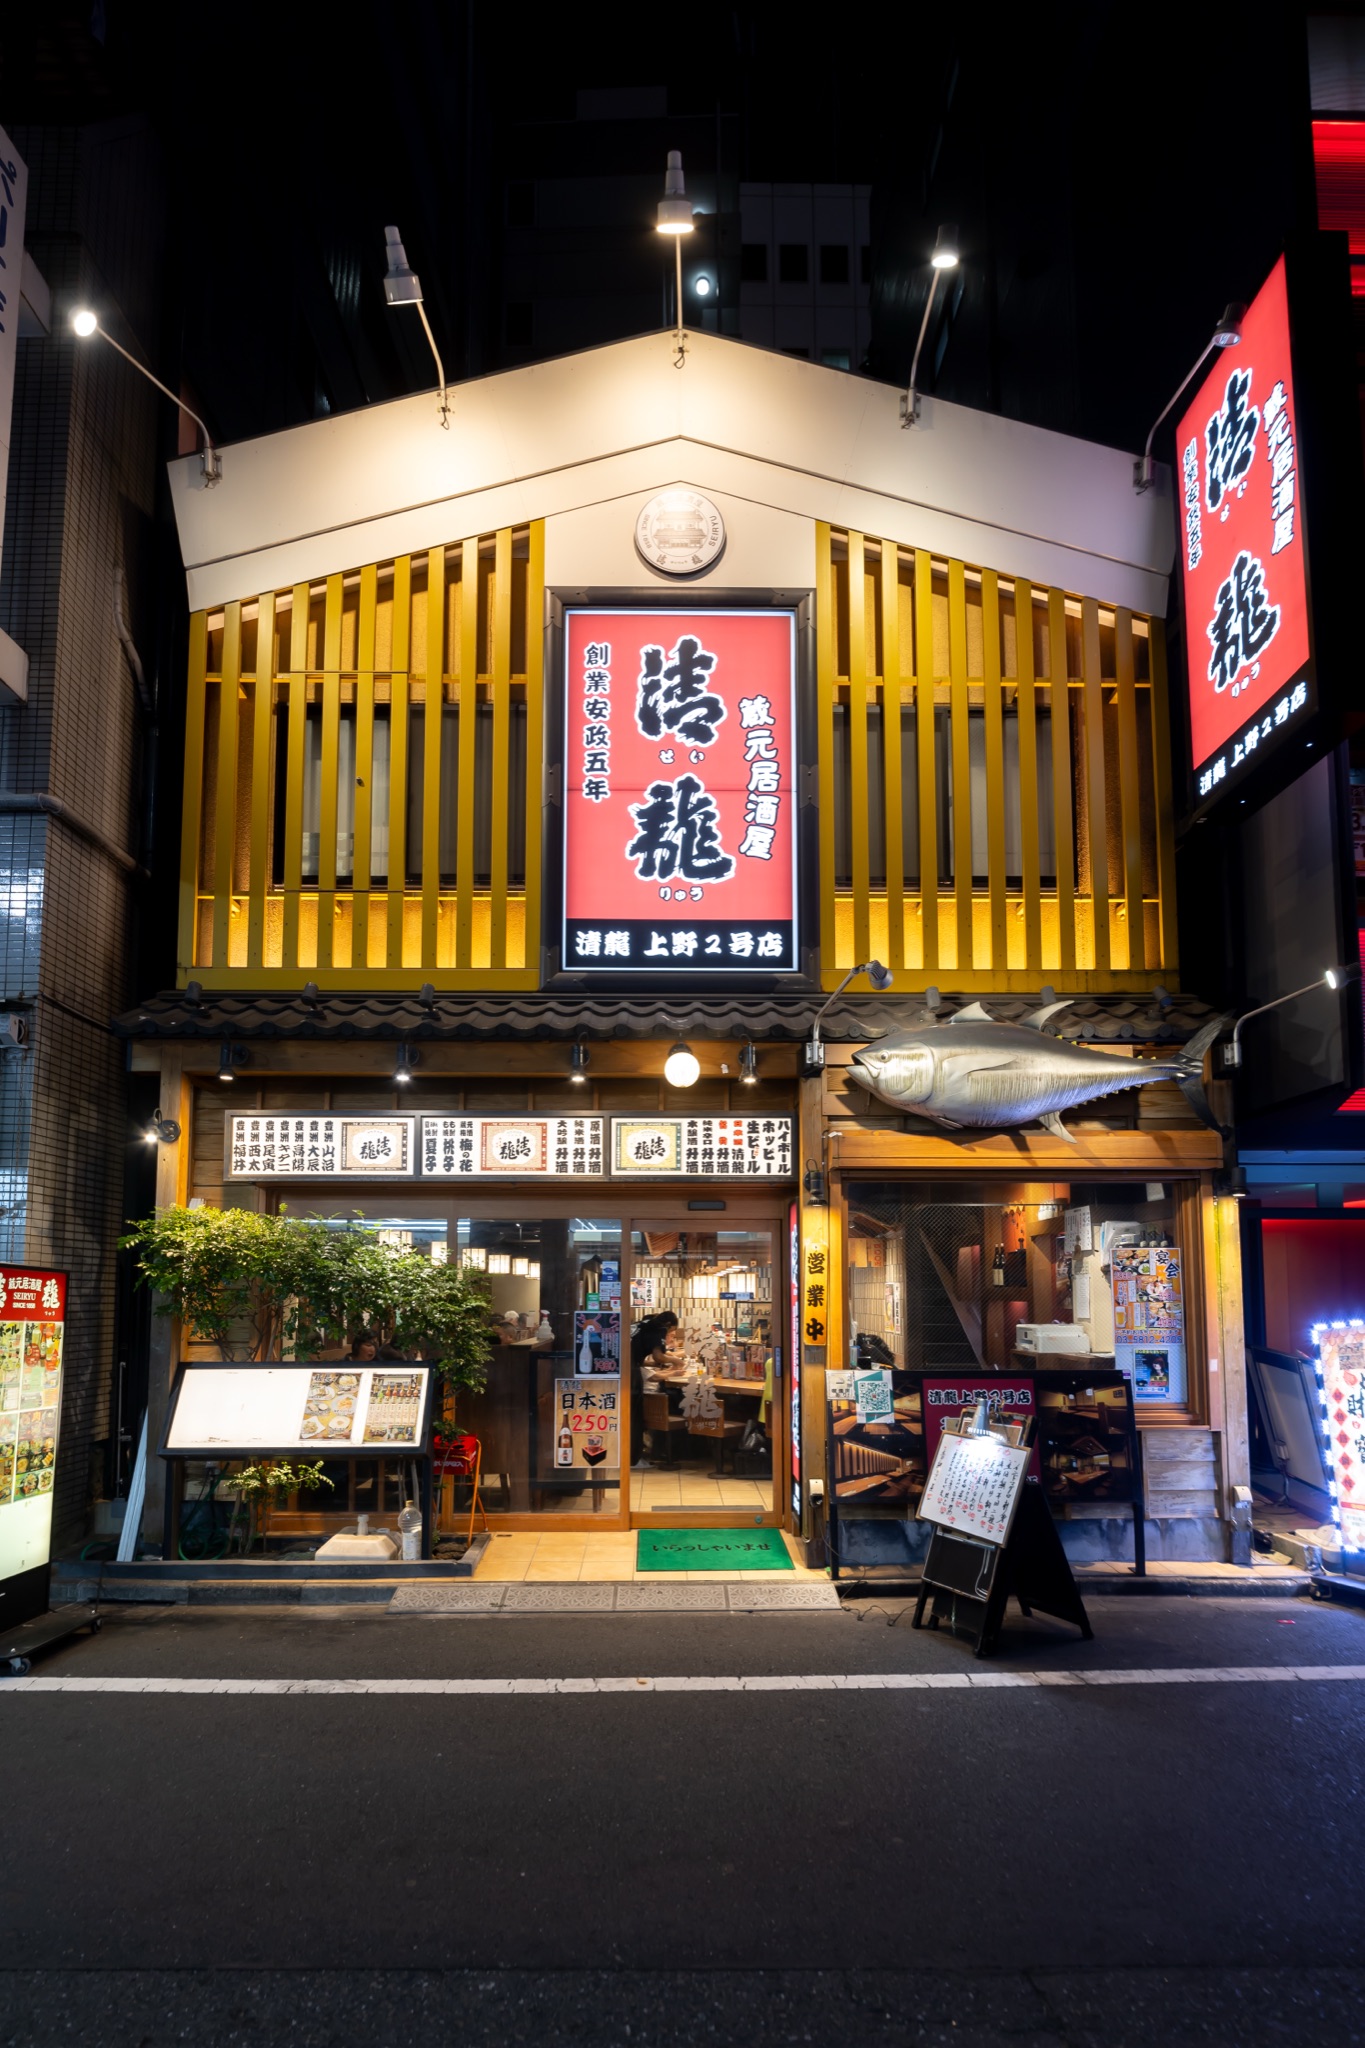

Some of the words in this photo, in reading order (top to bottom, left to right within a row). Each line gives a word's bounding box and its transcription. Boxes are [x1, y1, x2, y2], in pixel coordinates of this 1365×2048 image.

[708, 515, 719, 547] SEIRYU
[584, 643, 610, 801] 創業安政五年
[659, 749, 705, 764] せい
[739, 695, 781, 860] 蔵元居酒屋
[659, 886, 704, 902] りゅう
[575, 930, 631, 957] 清龍
[644, 930, 783, 957] 上野2号店
[459, 1138, 473, 1172] 梅の花
[747, 1120, 760, 1174] 生ビール
[762, 1120, 775, 1174] ホッピー
[777, 1120, 791, 1174] ハイボール
[1155, 1249, 1180, 1279] 宴会
[13, 1292, 36, 1300] SEIRYU
[806, 1252, 825, 1341] 営業中
[562, 1392, 616, 1410] 日本酒
[572, 1414, 608, 1431] 250
[652, 1542, 772, 1552] いらっしゃいませ
